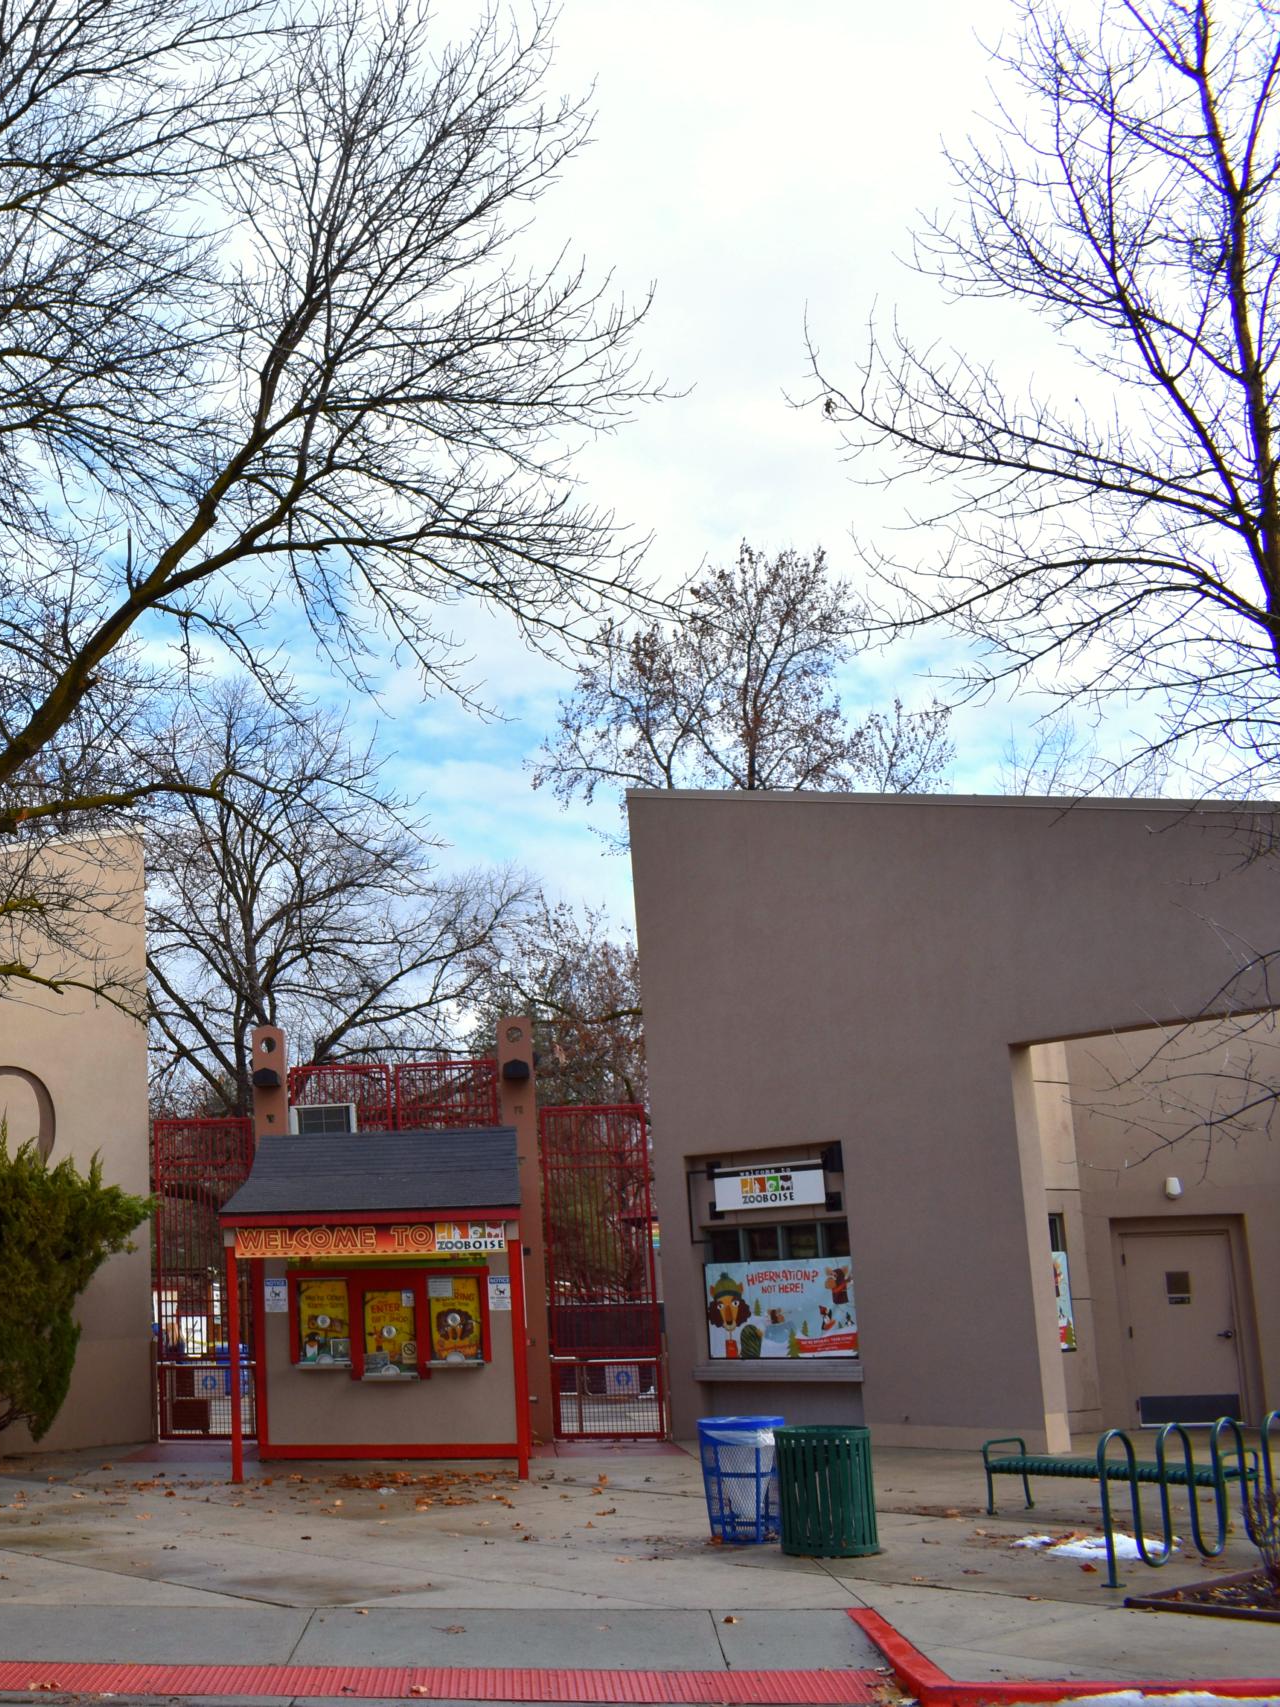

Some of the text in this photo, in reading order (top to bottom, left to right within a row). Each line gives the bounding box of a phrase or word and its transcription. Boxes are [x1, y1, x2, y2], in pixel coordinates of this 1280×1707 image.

[238, 1225, 433, 1250] WELCOME TO
[746, 1270, 819, 1286] HIBERNATION?
[761, 1283, 804, 1294] NOT HERE!
[371, 1303, 400, 1313] ENTER
